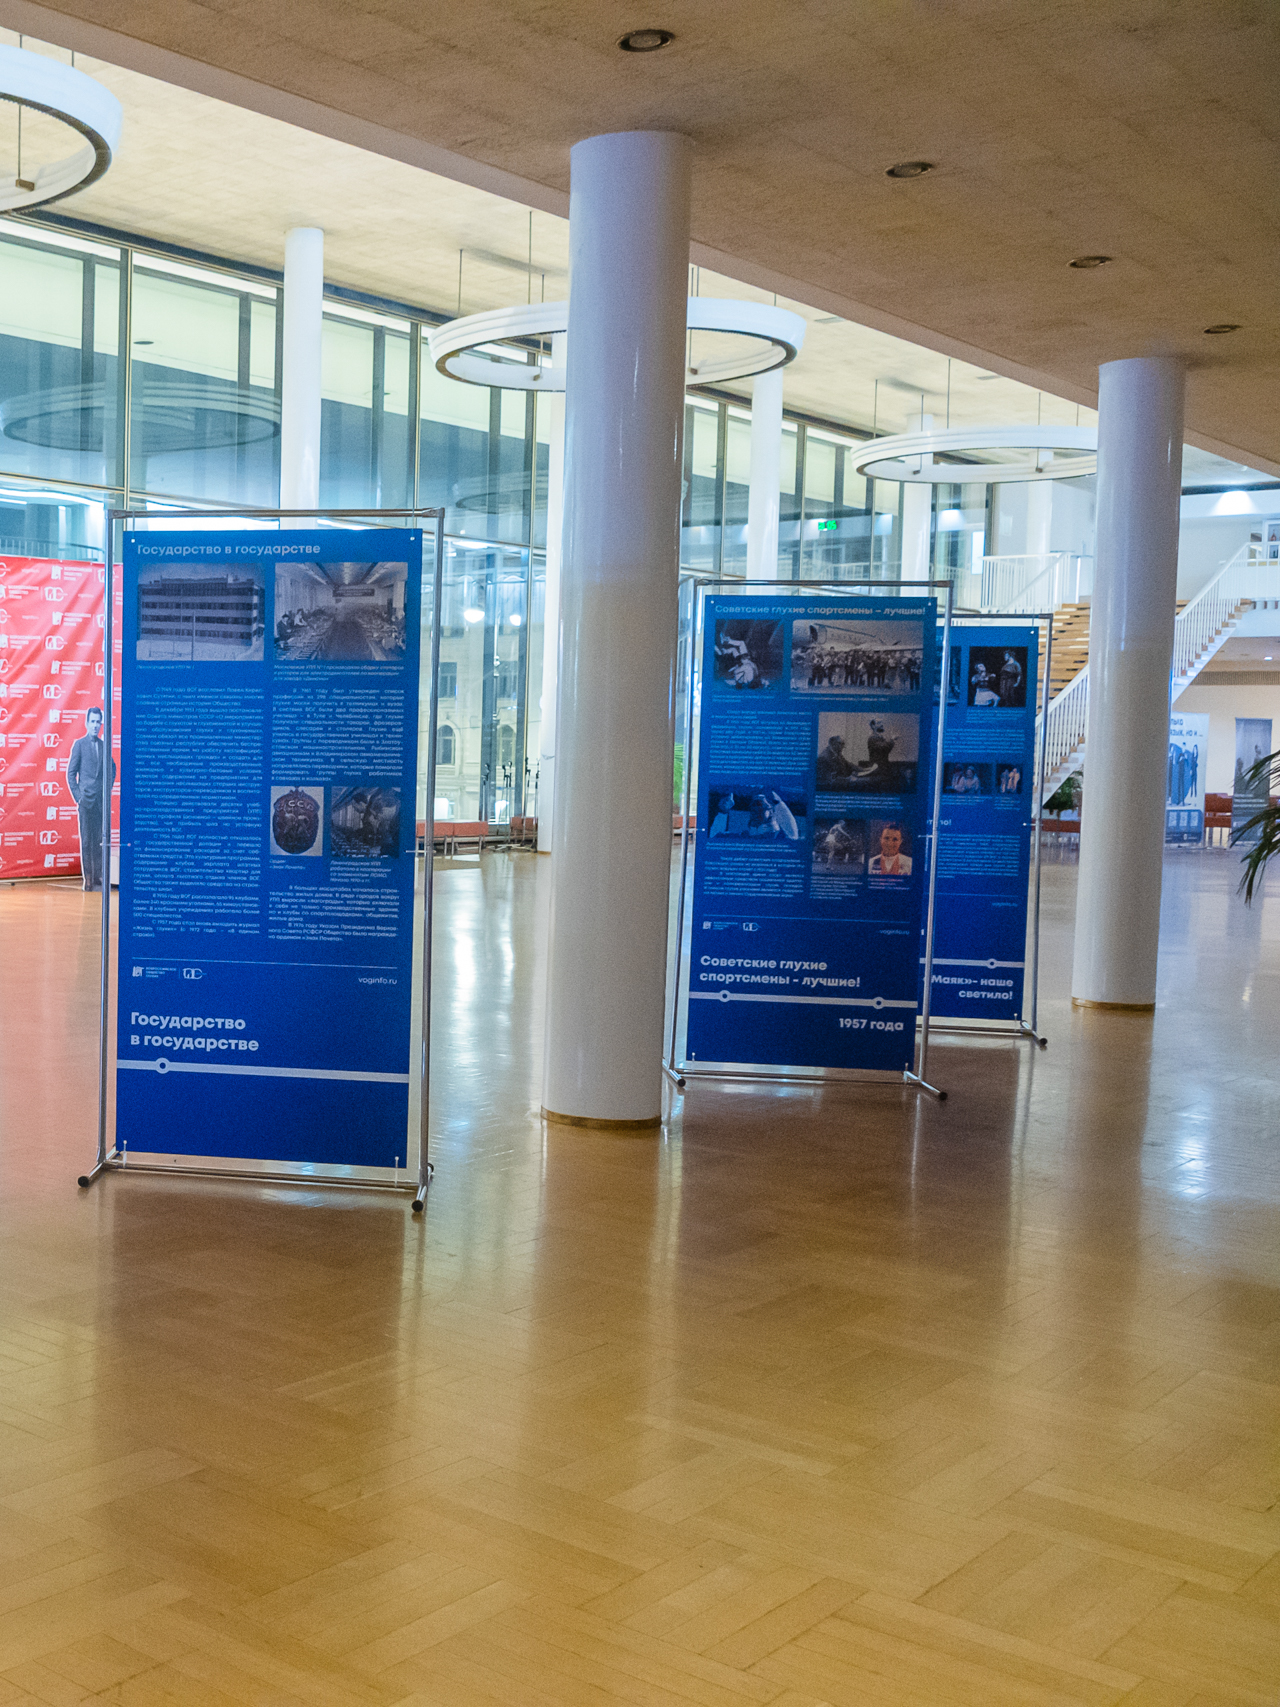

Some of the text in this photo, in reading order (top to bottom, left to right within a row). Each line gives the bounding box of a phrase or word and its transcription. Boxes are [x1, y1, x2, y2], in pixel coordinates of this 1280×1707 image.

[137, 544, 321, 556] Государство в государстве
[715, 605, 770, 613] Советские
[807, 607, 873, 615] спортсмены
[883, 607, 926, 616] лучшие!
[700, 955, 827, 972] Советские глухие
[358, 977, 398, 985] voginfo.ru
[699, 972, 790, 984] спортсмены
[801, 977, 860, 988] лучшие!
[980, 978, 1014, 987] наше
[958, 990, 1013, 1000] светило!
[131, 1012, 246, 1031] Государство
[839, 1018, 904, 1032] 1957 года
[130, 1034, 259, 1052] в государстве
